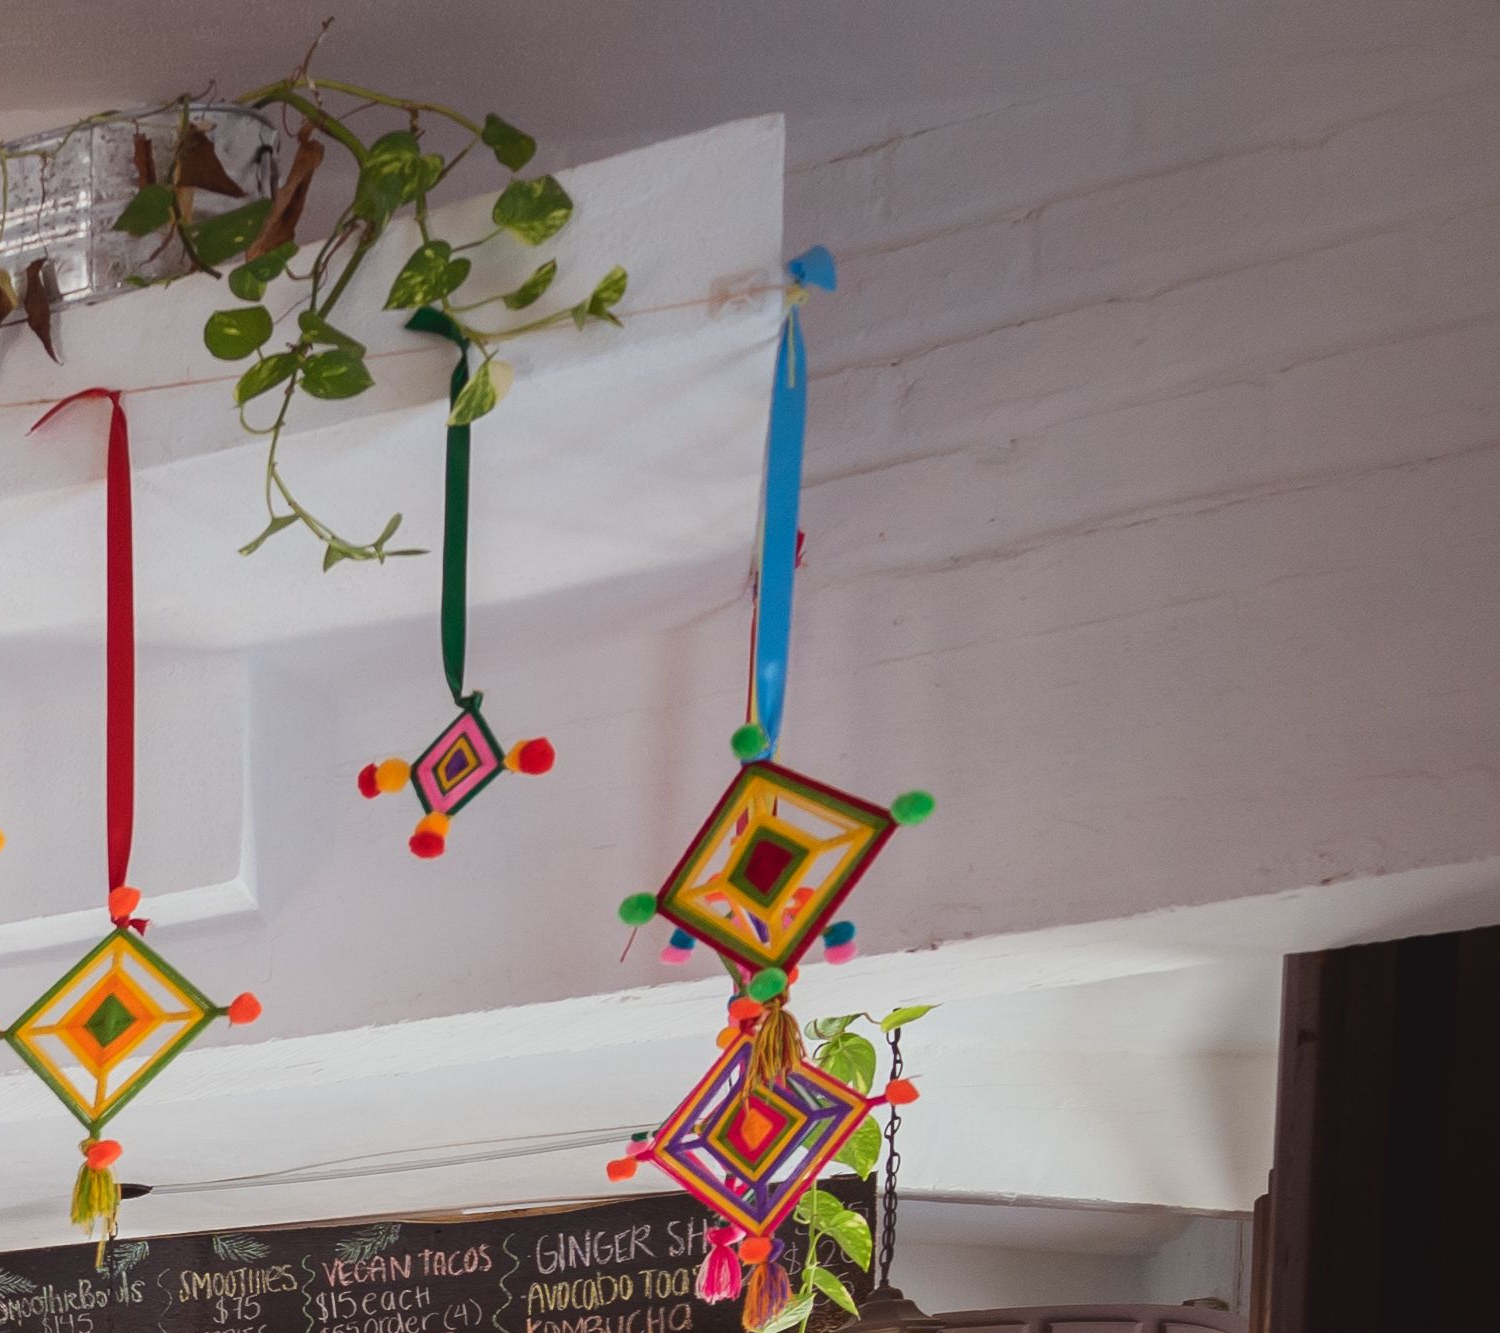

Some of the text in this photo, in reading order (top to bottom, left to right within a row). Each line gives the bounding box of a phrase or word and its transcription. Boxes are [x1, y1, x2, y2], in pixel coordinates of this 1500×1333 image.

[321, 1242, 492, 1287] VEGAN TACOS
[536, 1224, 656, 1275] GINGER
[213, 1294, 261, 1324] $75
[316, 1290, 357, 1323] $15
[443, 1298, 482, 1331] (4)
